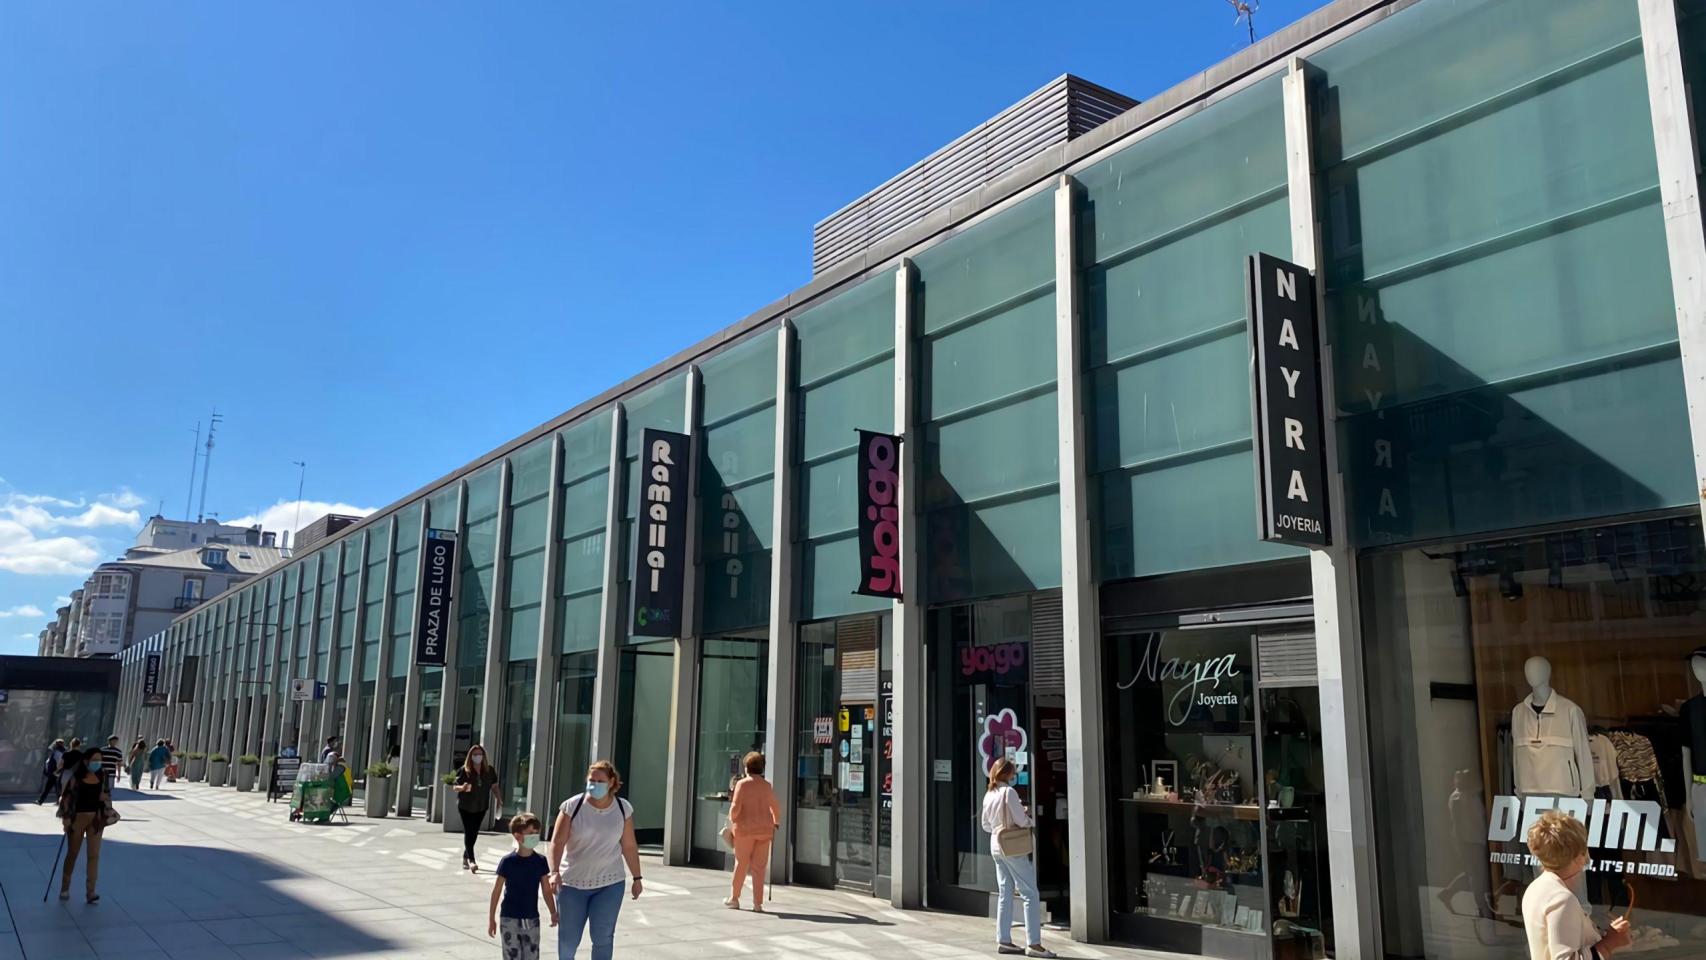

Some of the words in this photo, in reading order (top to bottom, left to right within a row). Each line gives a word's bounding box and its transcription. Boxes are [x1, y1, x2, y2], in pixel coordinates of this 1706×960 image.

[1276, 268, 1309, 502] NAYRA
[646, 439, 675, 593] Ramallal
[867, 436, 900, 593] yoigo
[1276, 513, 1322, 534] JOYERIA
[431, 545, 447, 584] LUGO
[429, 586, 443, 606] DE
[425, 608, 441, 656] PRAZA
[961, 644, 1025, 675] yoigo
[1116, 631, 1240, 726] Nayra
[1197, 691, 1239, 708] Joyería
[1490, 852, 1521, 865] MORE
[1600, 859, 1624, 873] IT'S
[1626, 863, 1635, 873] A
[1638, 863, 1678, 877] MOOD.
